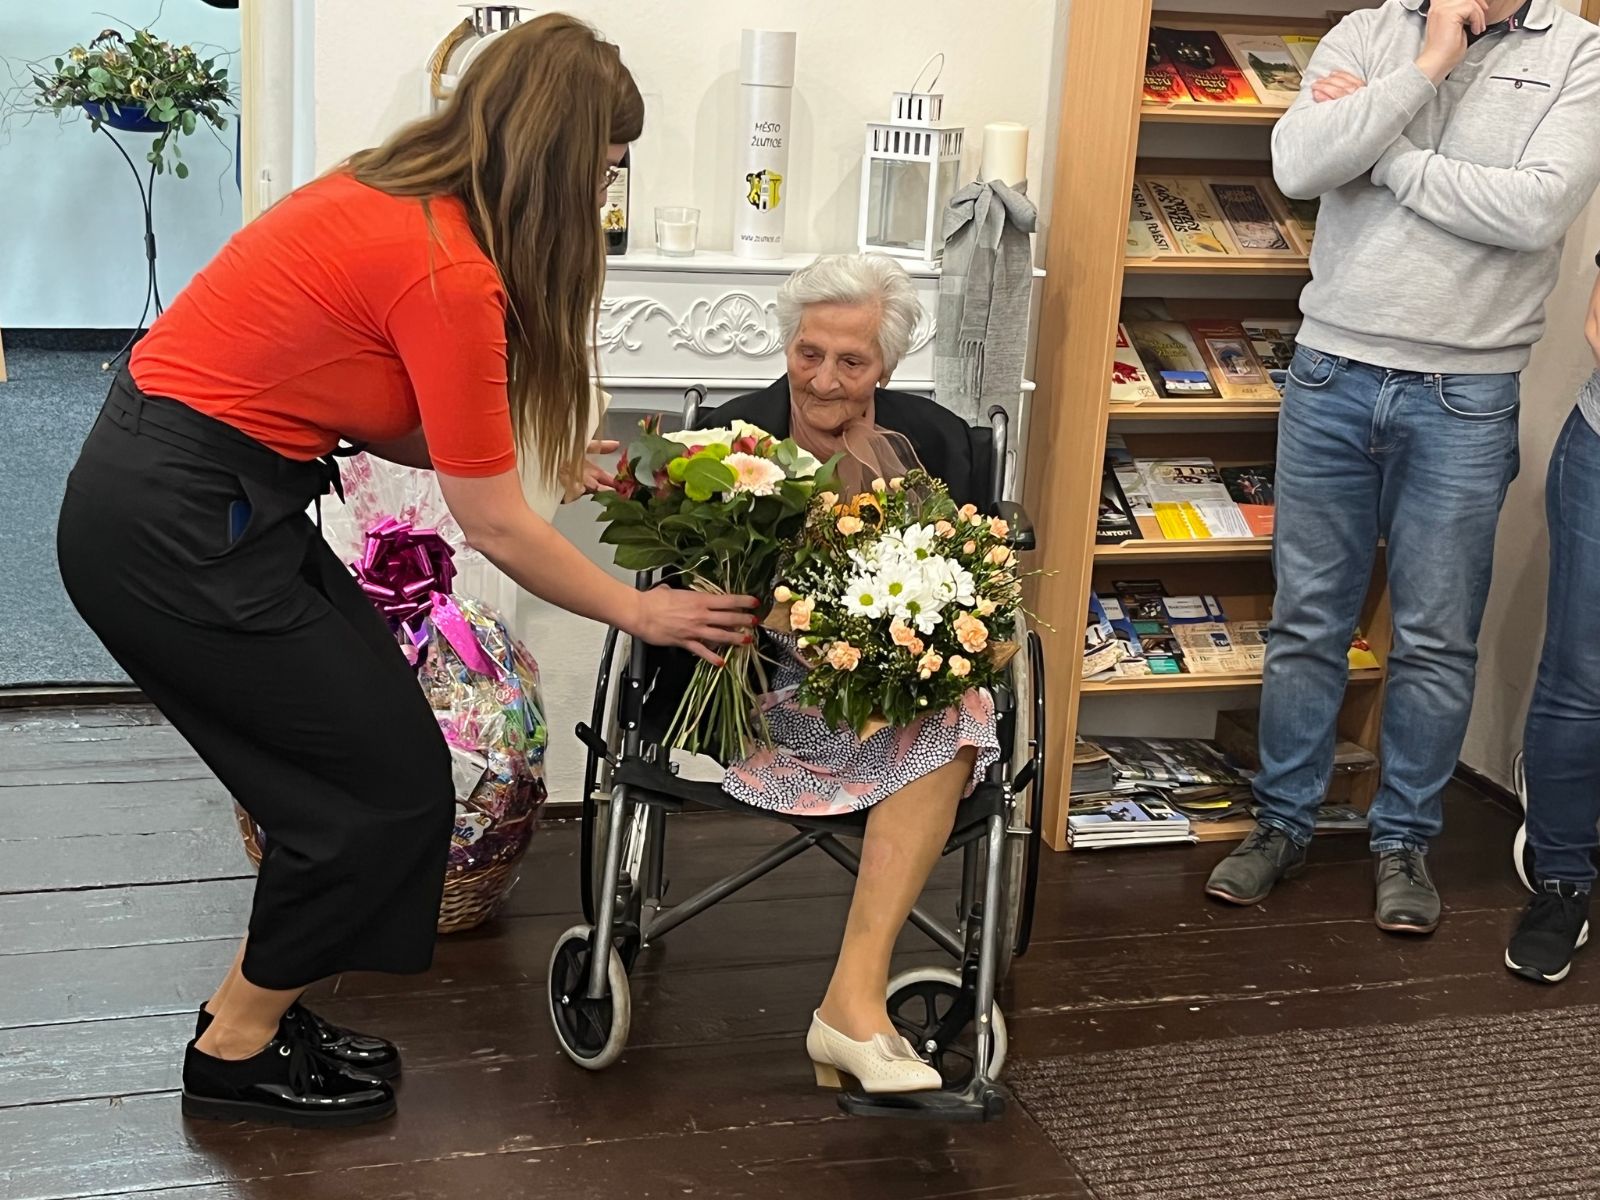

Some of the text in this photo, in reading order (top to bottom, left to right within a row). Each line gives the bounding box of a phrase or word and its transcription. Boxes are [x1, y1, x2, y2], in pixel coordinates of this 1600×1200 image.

[755, 121, 781, 133] MĚSTO
[751, 135, 782, 148] ŽLUTICE
[1140, 210, 1154, 221] ZA
